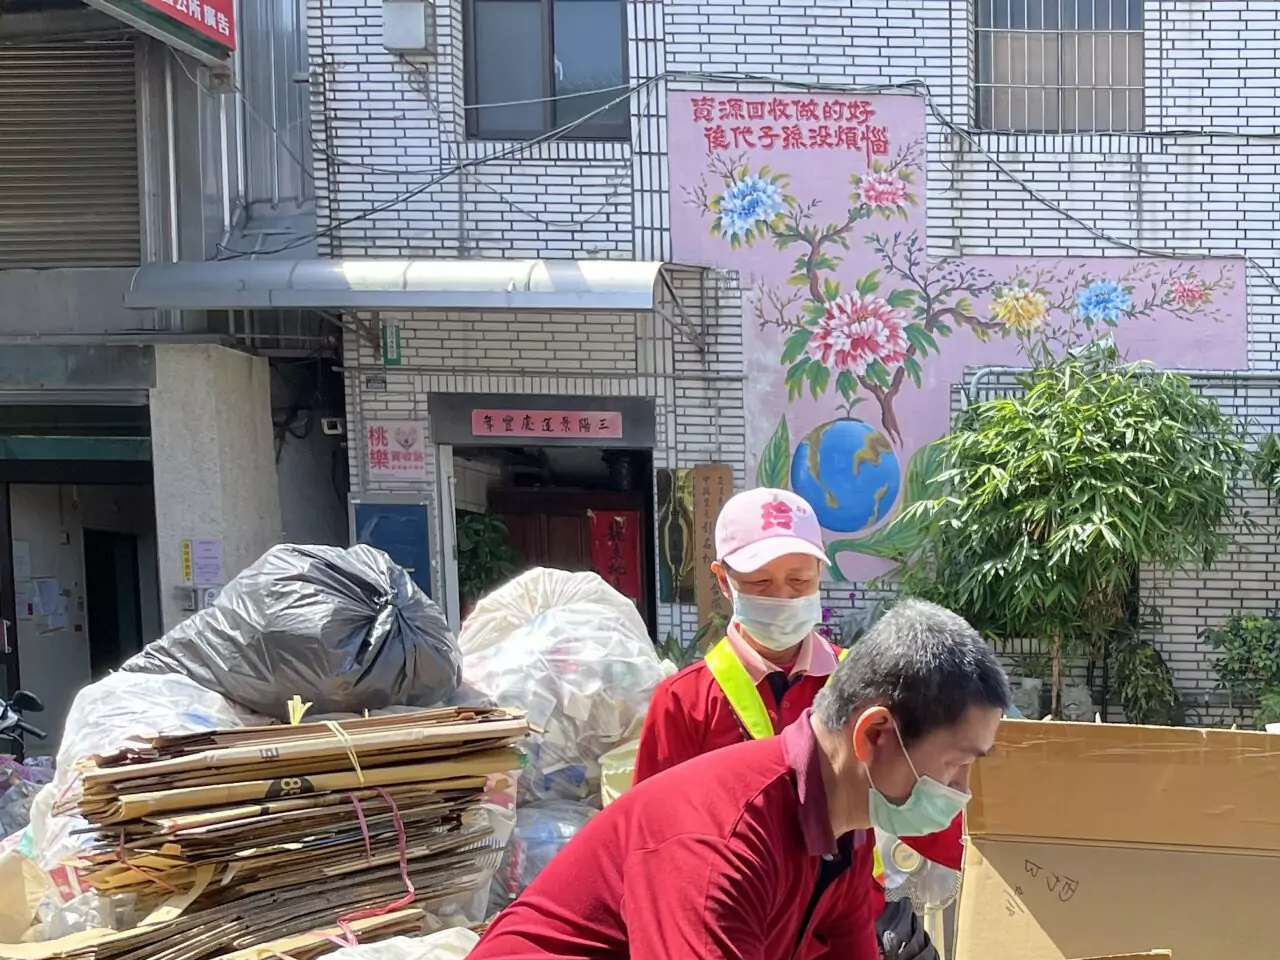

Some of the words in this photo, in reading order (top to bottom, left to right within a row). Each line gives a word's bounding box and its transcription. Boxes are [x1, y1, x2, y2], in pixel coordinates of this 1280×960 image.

[203, 4, 230, 37] 廣告
[691, 97, 877, 125] 資源回收做的好
